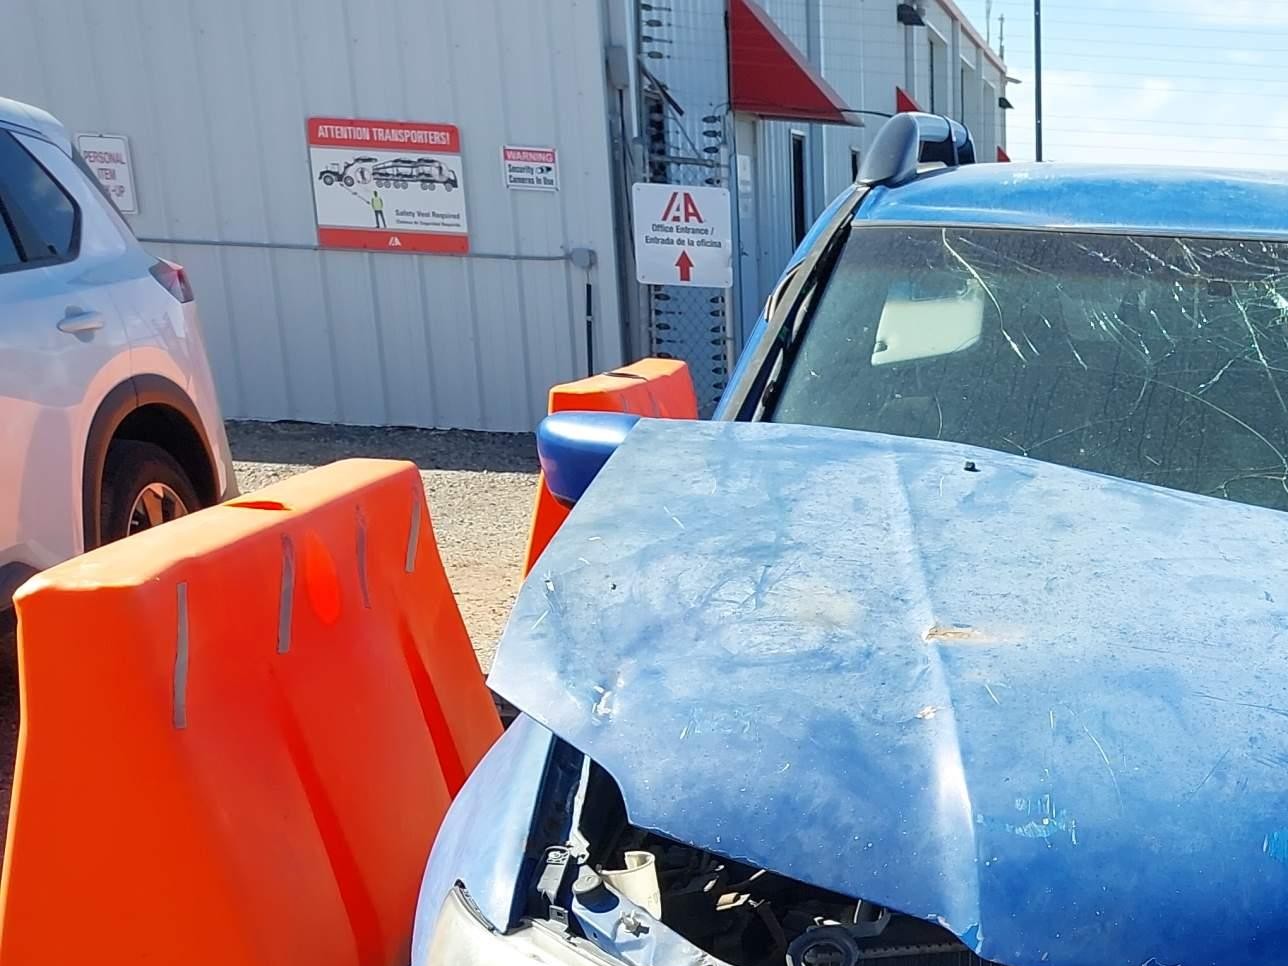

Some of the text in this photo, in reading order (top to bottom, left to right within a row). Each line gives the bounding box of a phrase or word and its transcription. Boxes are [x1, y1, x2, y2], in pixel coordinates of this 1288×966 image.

[318, 125, 450, 145] ATTENTION TRANSPORTERS!
[83, 150, 126, 165] PERSONAL
[505, 150, 553, 163] WARNING
[97, 167, 117, 181] ITEM
[508, 164, 534, 175] Security
[509, 175, 535, 184] Cameras
[543, 176, 554, 186] Use
[395, 208, 415, 218] Safety
[651, 223, 674, 233] Office
[675, 225, 709, 235] Entrance
[645, 235, 722, 248] Entrada de la oficina
